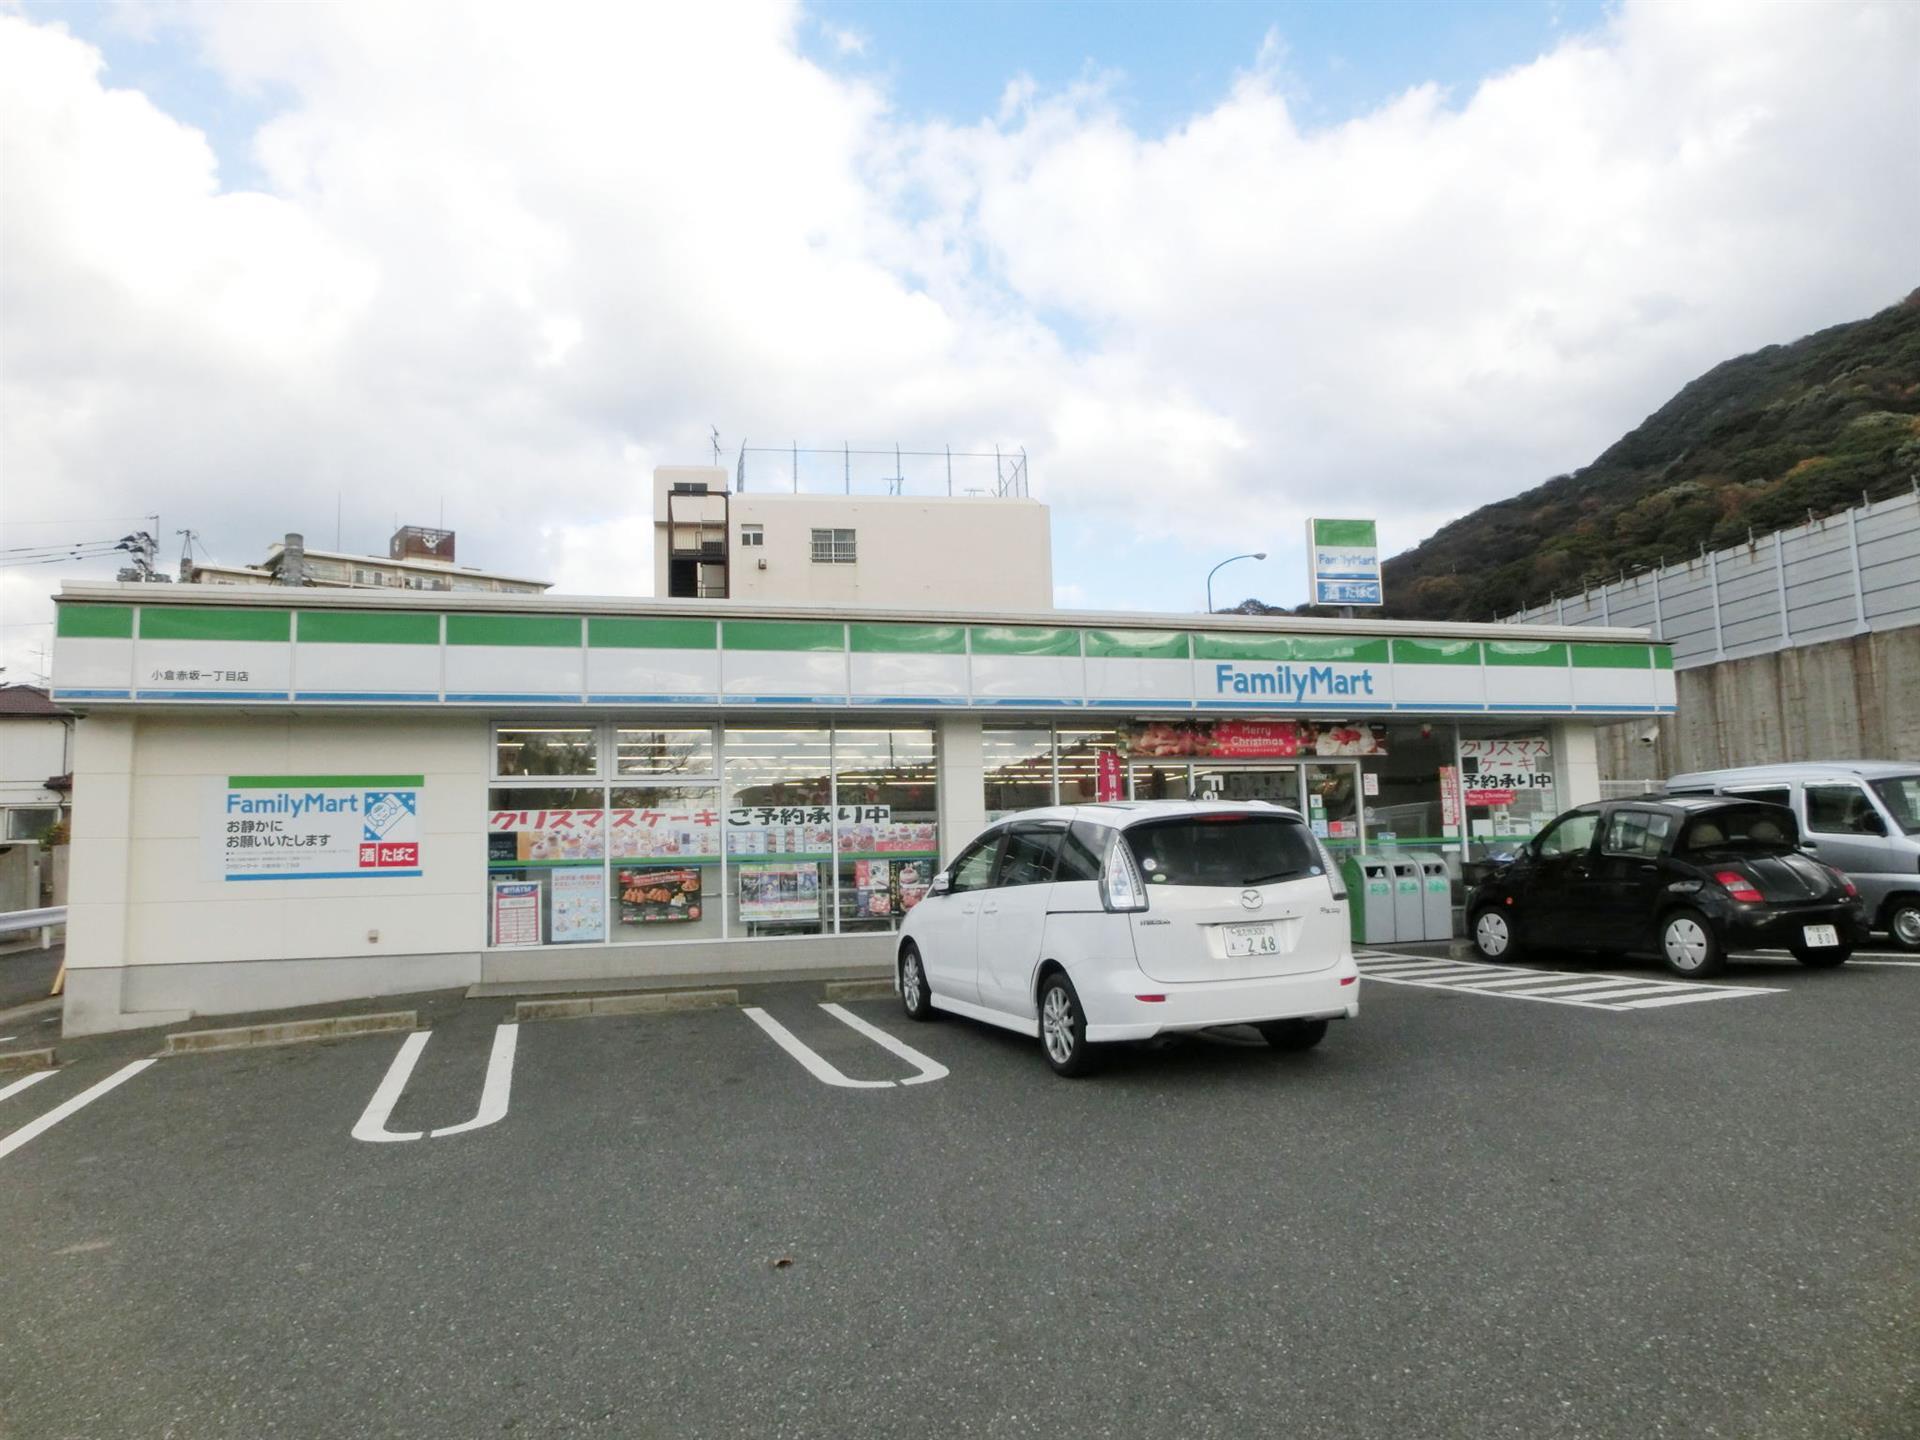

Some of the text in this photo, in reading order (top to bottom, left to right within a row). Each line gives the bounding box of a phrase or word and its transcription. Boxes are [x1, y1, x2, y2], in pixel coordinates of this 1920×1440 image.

[1318, 553, 1377, 567] FalyMart
[151, 669, 249, 682] 小倉赤坂一丁目店
[1216, 664, 1373, 703] FamilyMart
[1241, 725, 1271, 736] Merry
[1231, 736, 1284, 746] Christmas
[1461, 741, 1549, 756] クリスマス
[1481, 757, 1535, 772] ケーキ
[1463, 774, 1551, 789] 予約承り中
[227, 793, 358, 817] FamilyMart
[490, 806, 889, 830] クリスマスケーキ ご予約承り中
[227, 820, 283, 833] お静かに
[226, 834, 331, 849] お願いいたします
[361, 848, 375, 862] 酒
[381, 847, 415, 862] たばこ
[1246, 936, 1276, 953] 248
